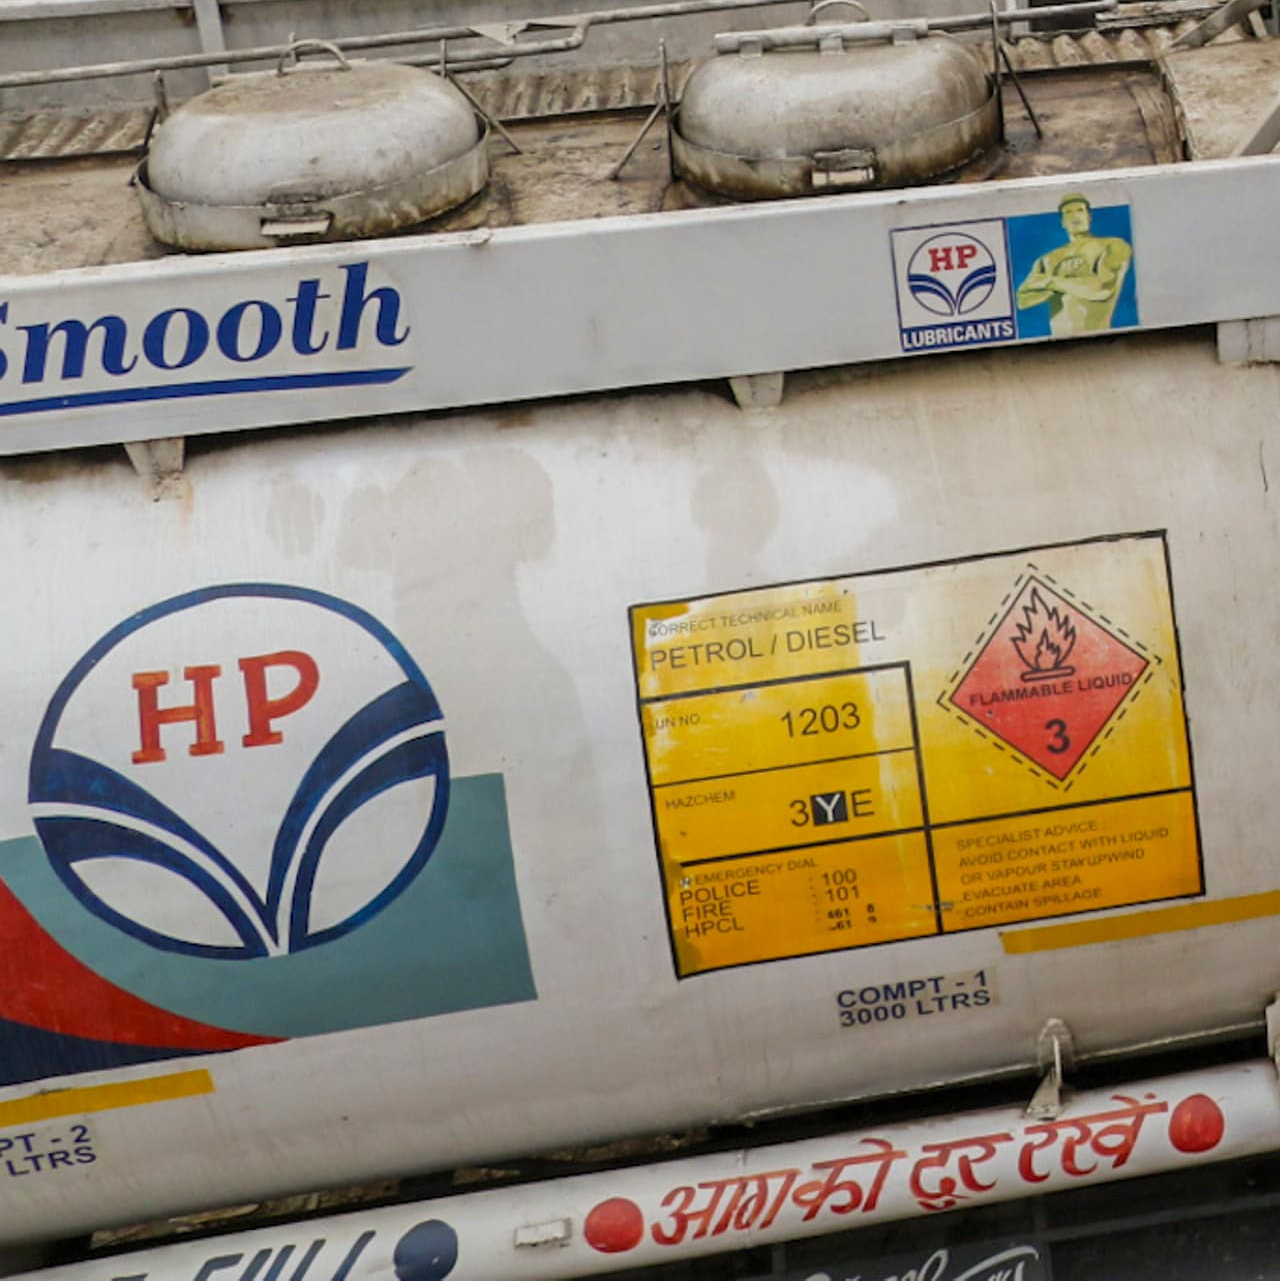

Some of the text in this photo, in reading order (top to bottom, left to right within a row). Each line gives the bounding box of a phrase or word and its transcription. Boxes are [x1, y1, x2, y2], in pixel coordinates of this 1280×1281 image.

[928, 243, 977, 273] HP
[0, 260, 410, 385] mooth
[902, 321, 1014, 350] LUBRICANTS
[648, 600, 842, 638] CORRECT TECHNICAL NAME
[651, 638, 764, 672] PETROL
[786, 620, 886, 653] DIESEL
[969, 671, 1134, 707] FLAMMABLE LIQUID
[130, 650, 320, 766] HP
[679, 713, 700, 726] NO
[781, 702, 861, 738] 1203
[1045, 718, 1071, 754] 3
[665, 790, 735, 810] HAZCHEM
[789, 788, 875, 828] 3YE
[956, 820, 1098, 851] SPECIALIST ADVICE
[959, 826, 1169, 869] AVOID CONTACT WITH LIQUID
[679, 868, 858, 907] POLICE 100
[695, 858, 817, 886] EMERGENCY DIAL
[960, 873, 982, 886] OR
[988, 862, 1047, 883] VAPOUR
[962, 875, 1082, 902] EVACUATE AREA
[682, 885, 860, 923] FIRE 101
[964, 887, 1103, 919] CONTAIN SPILLAGE
[685, 917, 744, 939] HPCL
[837, 976, 945, 1008] COMPT
[974, 970, 987, 987] 1
[839, 989, 991, 1028] 3000 LTRS
[73, 1125, 91, 1144] 2
[8, 1146, 97, 1177] LTRS
